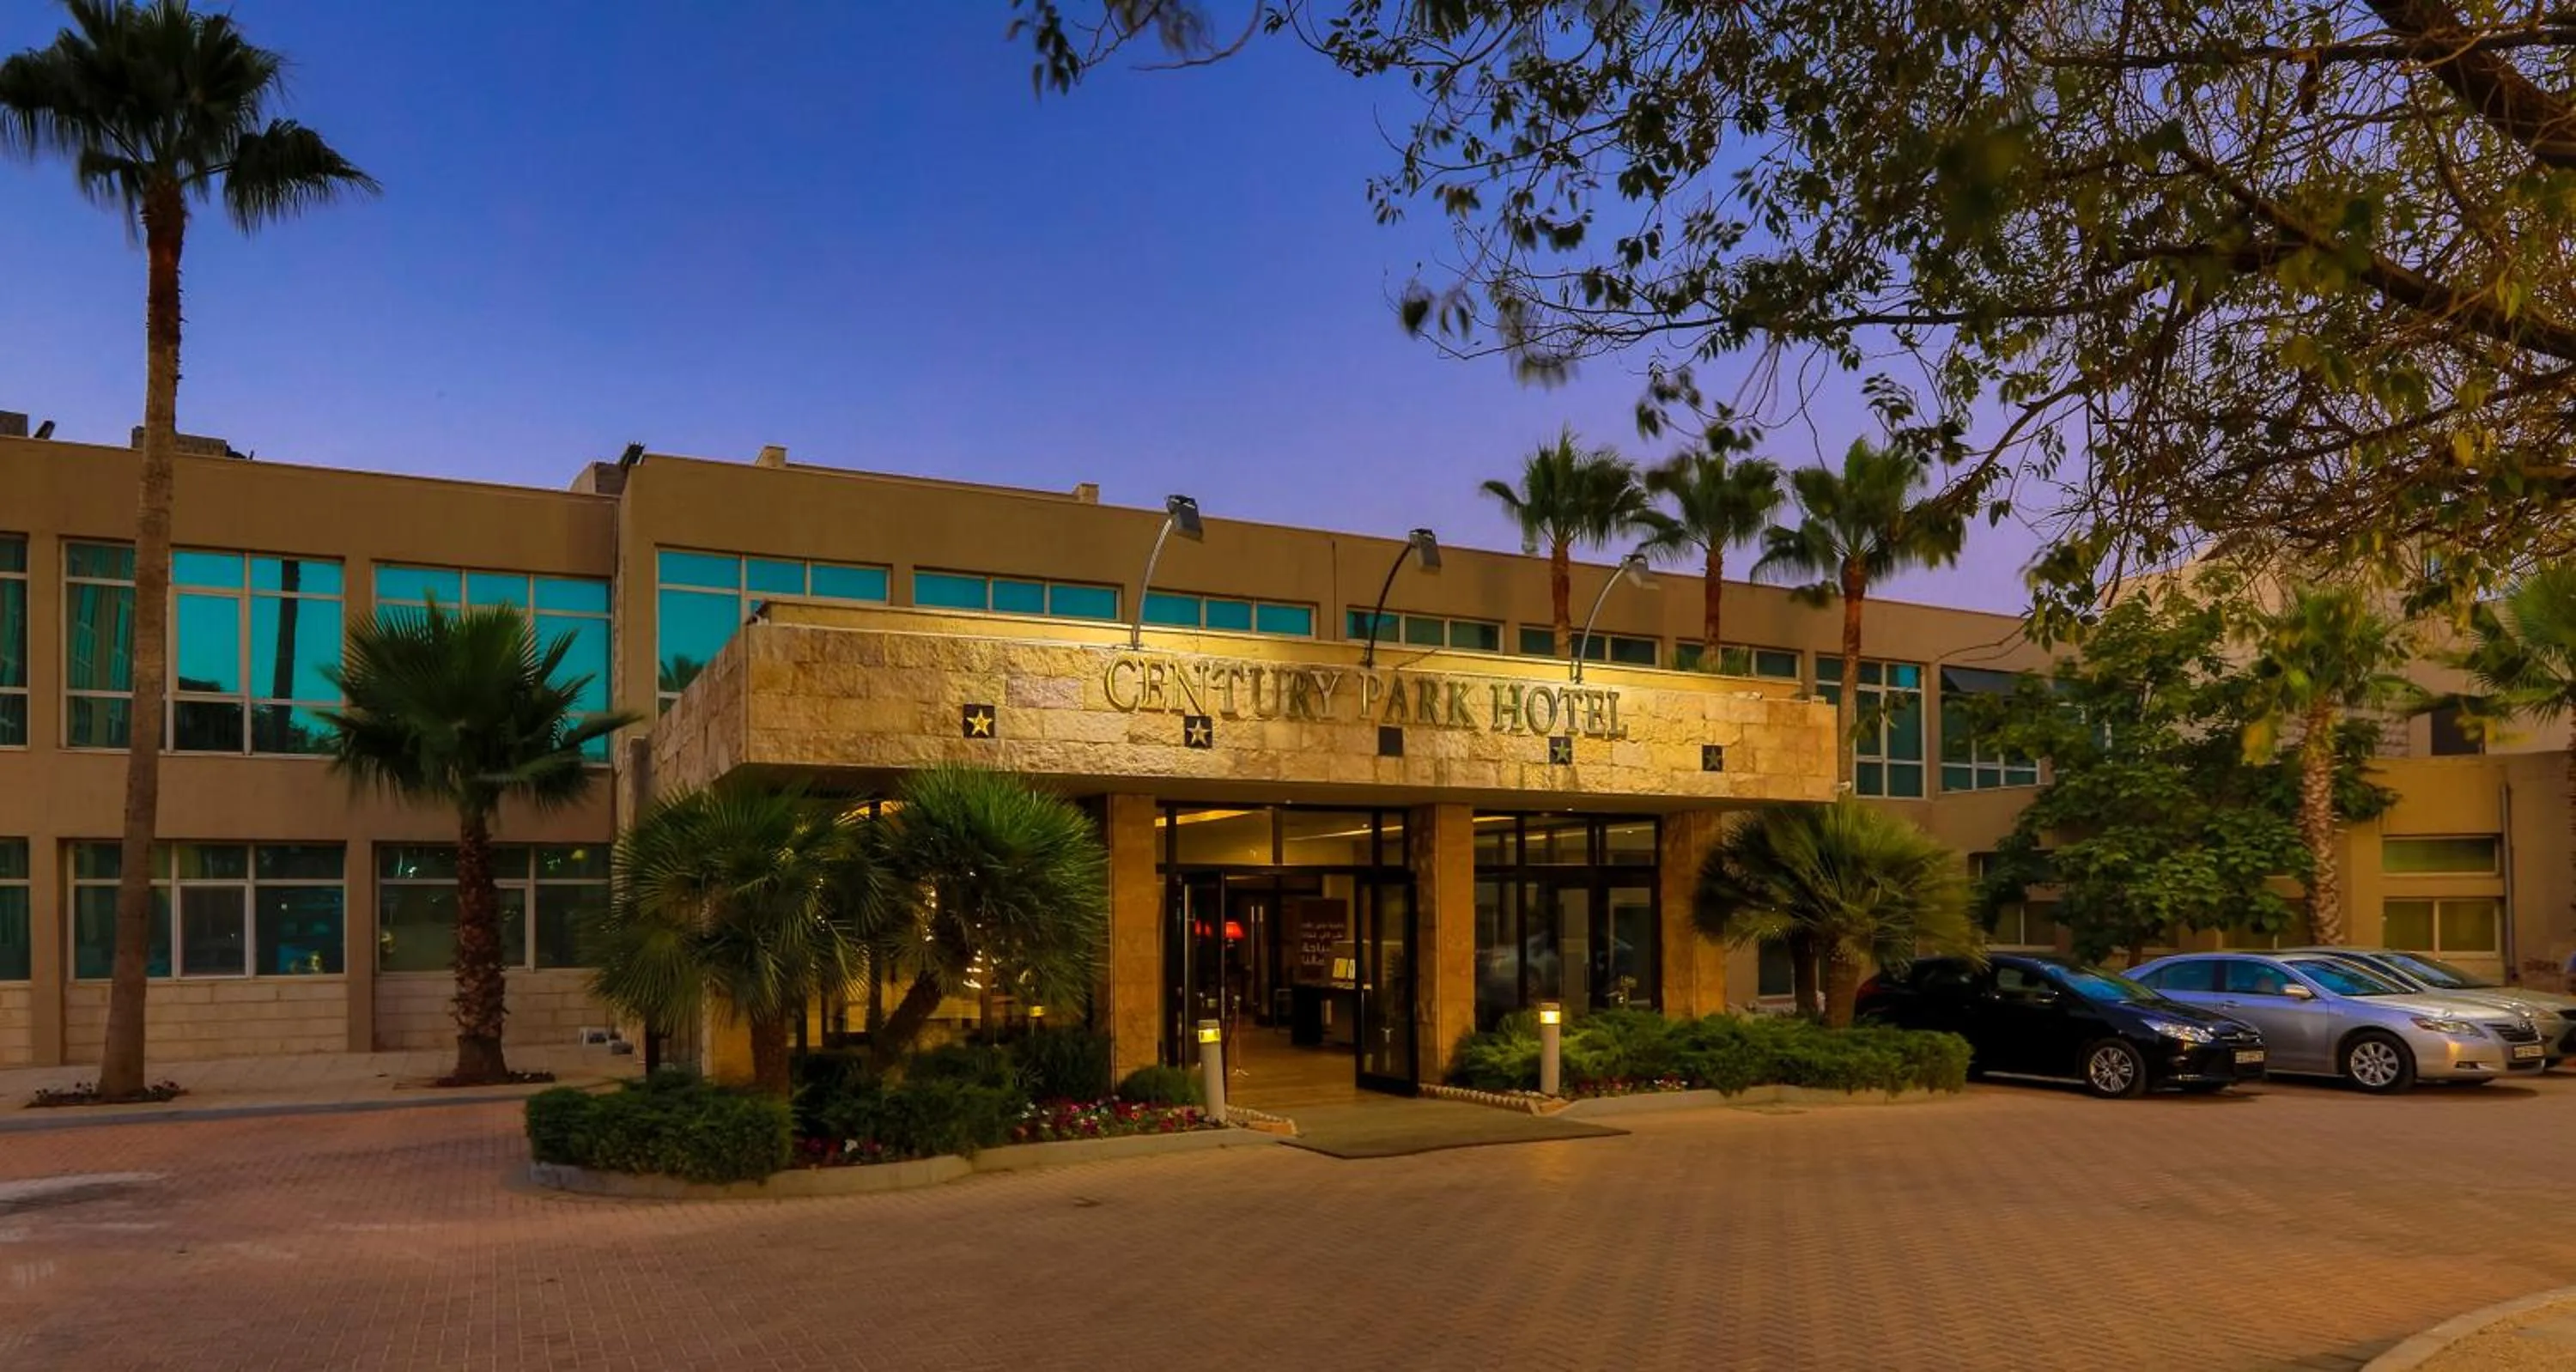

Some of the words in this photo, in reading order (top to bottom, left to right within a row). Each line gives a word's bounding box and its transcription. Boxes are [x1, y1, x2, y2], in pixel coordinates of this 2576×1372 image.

[1103, 659, 1342, 722] CENTURY
[1358, 670, 1479, 730] PARK
[1489, 683, 1629, 741] HOTEL
